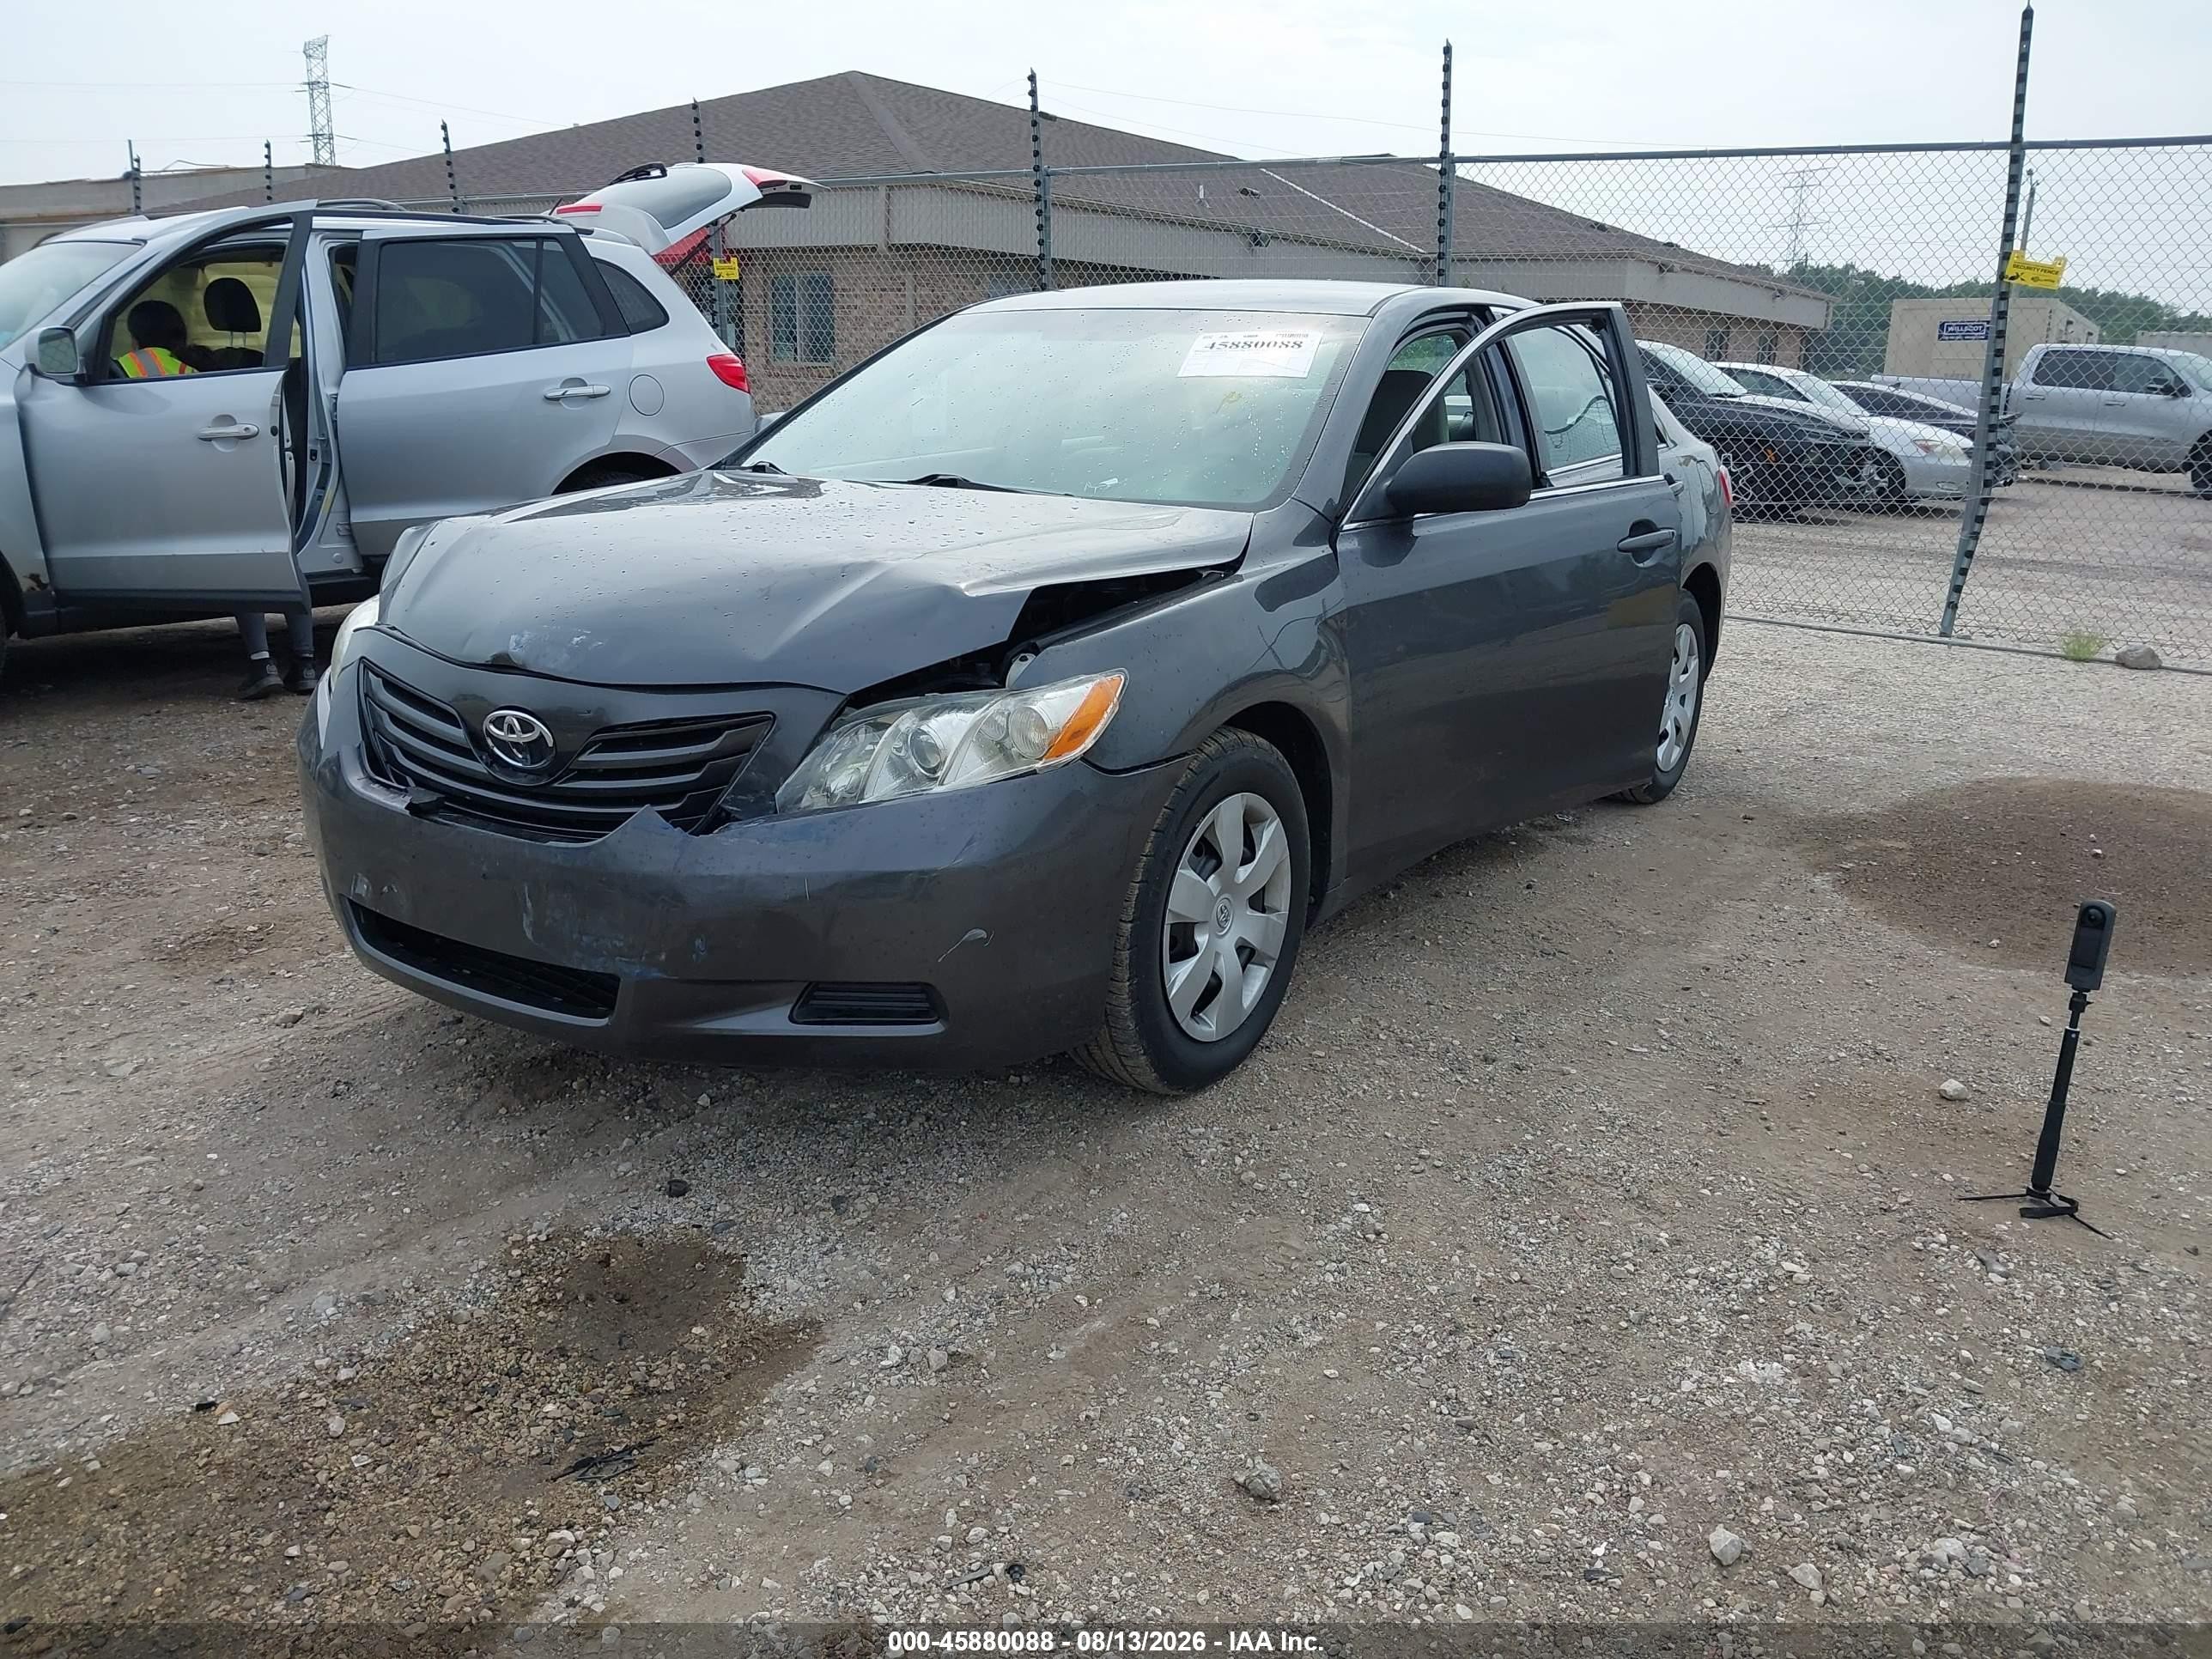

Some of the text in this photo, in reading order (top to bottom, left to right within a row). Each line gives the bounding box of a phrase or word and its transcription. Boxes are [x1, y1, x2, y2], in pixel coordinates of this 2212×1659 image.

[2012, 264, 2060, 276] SECURITY FENCE
[1203, 340, 1304, 350] 45880088
